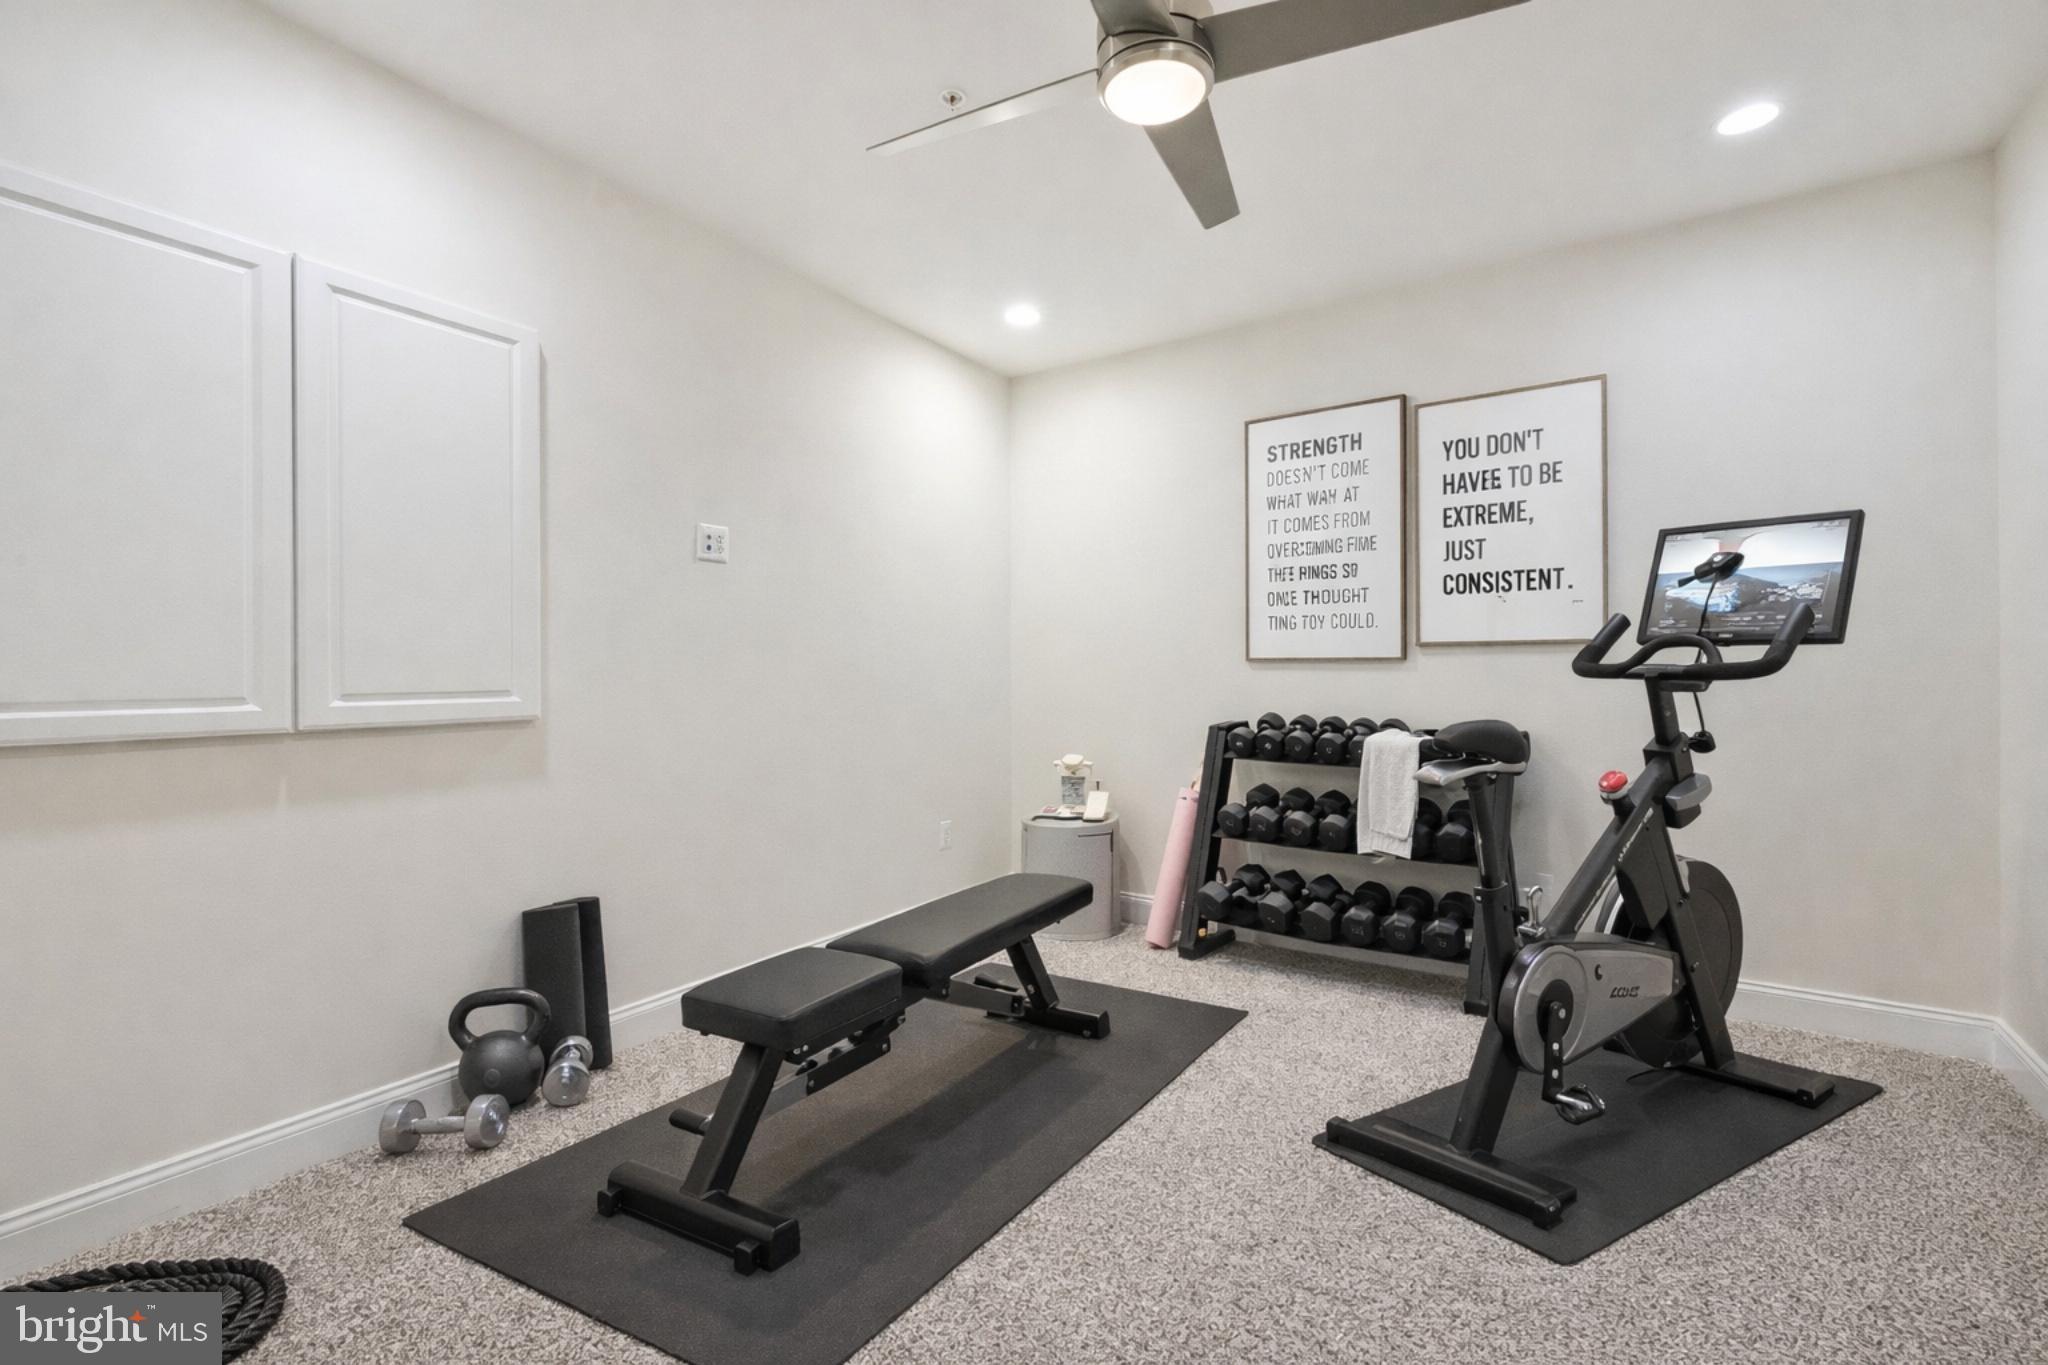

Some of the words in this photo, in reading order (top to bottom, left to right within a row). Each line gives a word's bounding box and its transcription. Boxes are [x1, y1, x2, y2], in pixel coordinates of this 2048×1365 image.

[1267, 432, 1362, 463] STRENGTH
[1442, 436, 1480, 462] YOU
[1487, 428, 1544, 456] DON'T
[1267, 464, 1326, 487] DOESN'T
[1331, 458, 1369, 479] COME
[1507, 464, 1532, 488] TO
[1539, 461, 1563, 485] BE
[1266, 492, 1302, 511] WHAT
[1344, 486, 1360, 502] AT
[1267, 519, 1279, 535] IT
[1284, 514, 1329, 534] COMES
[1334, 510, 1370, 529] FROM
[1443, 500, 1534, 529] EXTREME,
[1443, 538, 1487, 562] JUST
[1443, 567, 1573, 596] CONSISTENT.
[1303, 587, 1370, 605] THOUGHT
[1268, 615, 1297, 631] TING
[1302, 614, 1325, 630] TOY
[1330, 612, 1379, 629] COULD.
